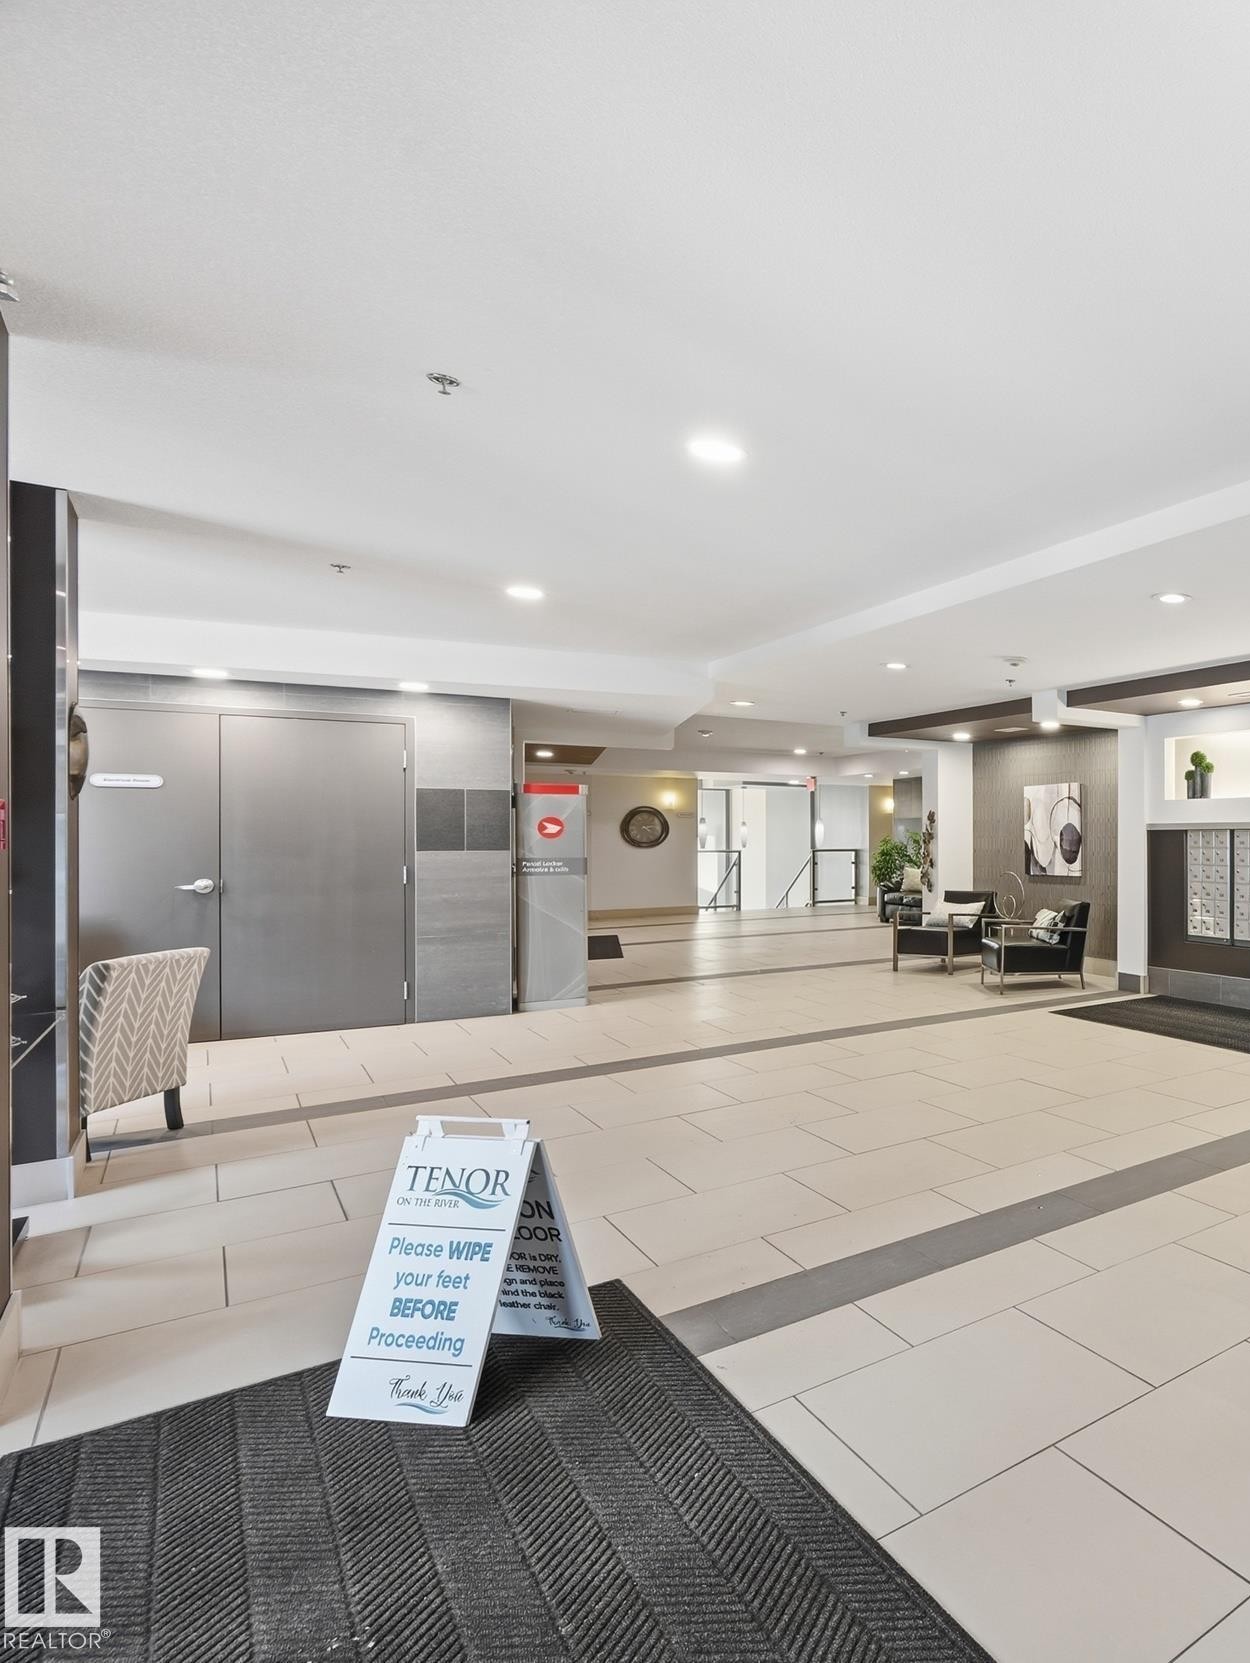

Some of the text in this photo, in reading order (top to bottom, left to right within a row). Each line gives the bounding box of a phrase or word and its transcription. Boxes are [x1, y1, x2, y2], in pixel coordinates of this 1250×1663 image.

[407, 1165, 511, 1196] TENOR
[396, 1196, 460, 1208] ON THE RIVER
[388, 1237, 493, 1262] Please WIPE
[393, 1270, 470, 1290] your feet
[519, 1277, 537, 1286] and
[521, 1288, 537, 1298] the
[389, 1296, 459, 1321] BEFORE
[367, 1326, 465, 1358] Proceeding
[388, 1374, 465, 1409] Thank You
